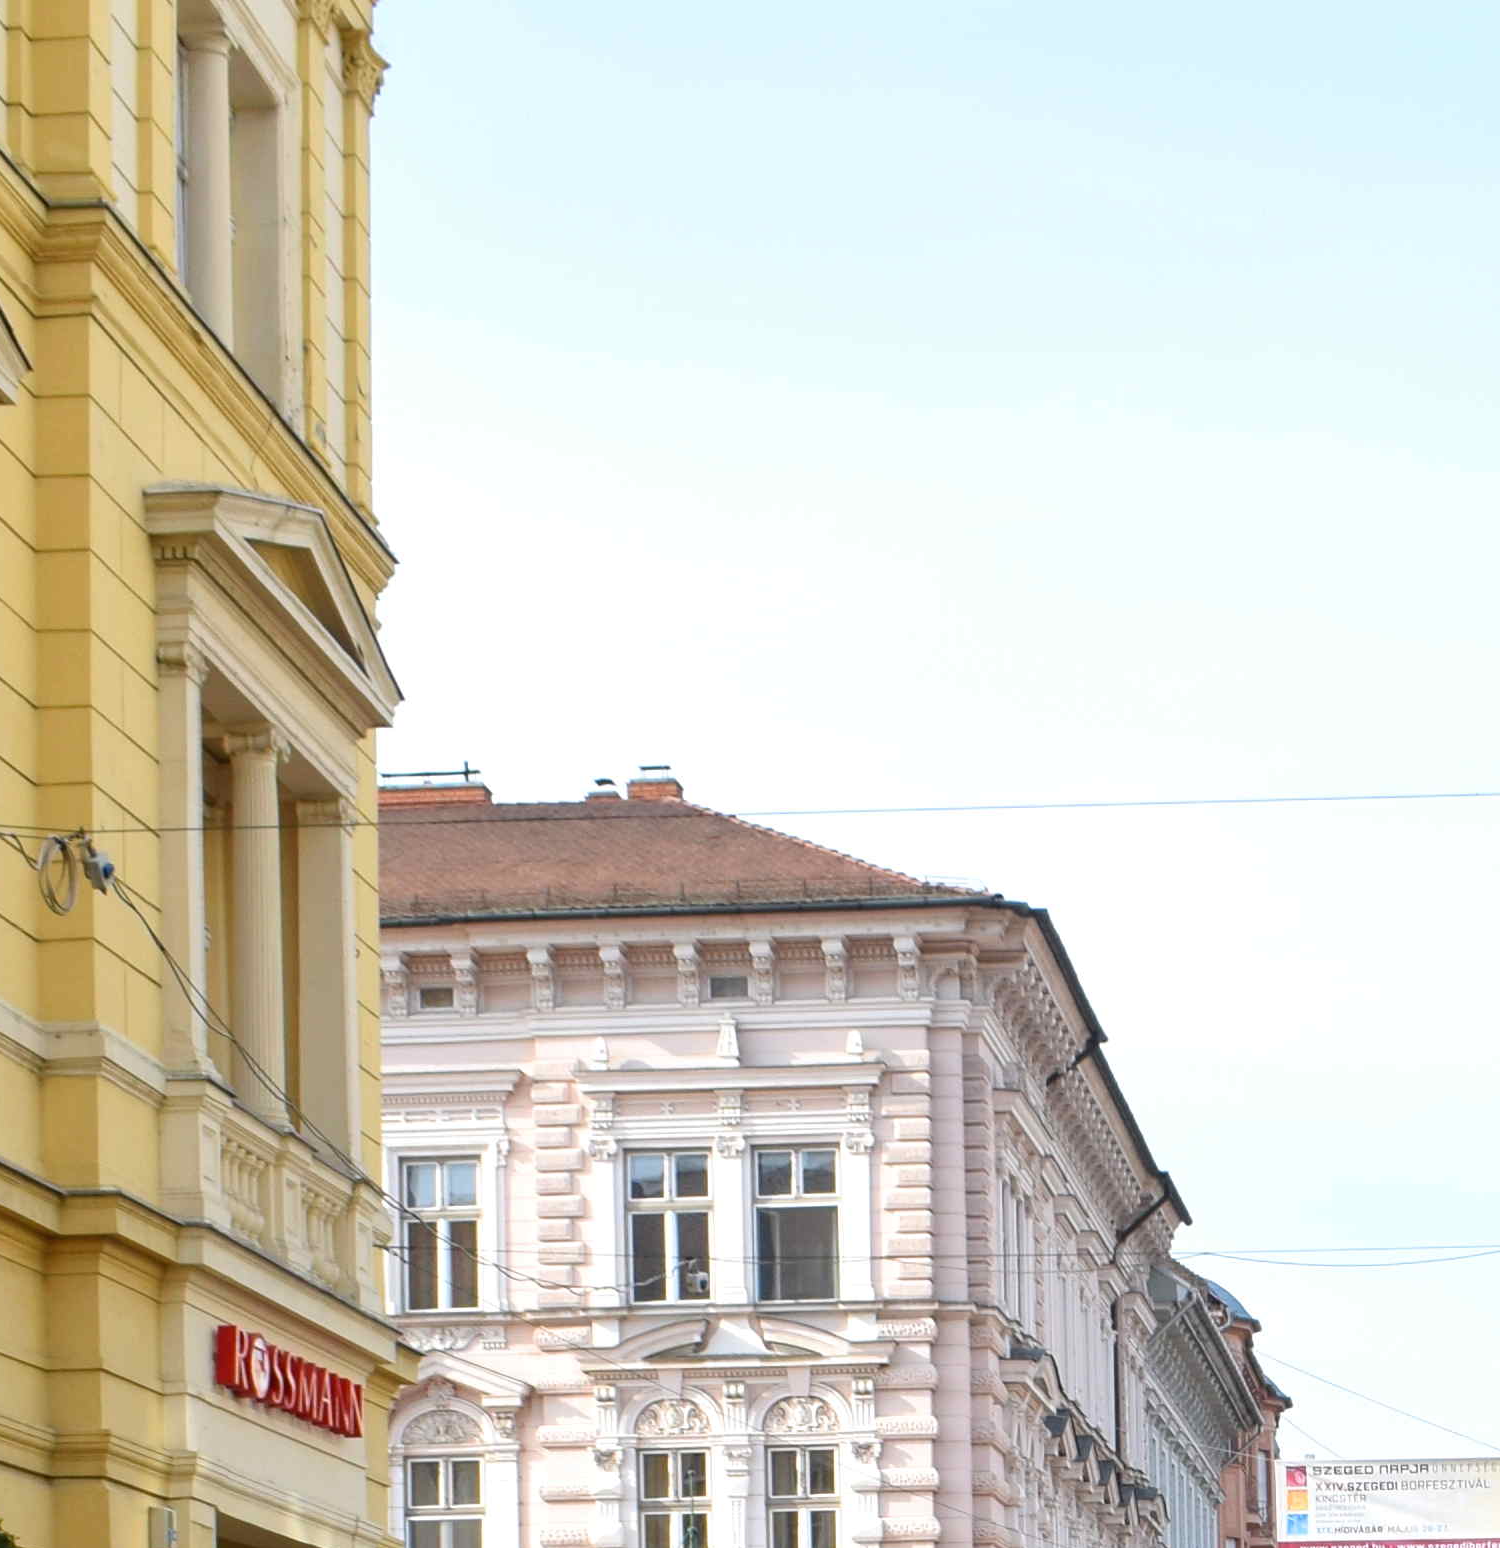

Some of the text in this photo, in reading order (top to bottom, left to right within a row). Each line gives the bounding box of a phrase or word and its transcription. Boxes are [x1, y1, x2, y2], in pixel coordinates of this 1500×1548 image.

[222, 1325, 366, 1438] ROSSMANN
[1313, 1465, 1374, 1475] SZEGED
[1380, 1463, 1429, 1475] NAPJA
